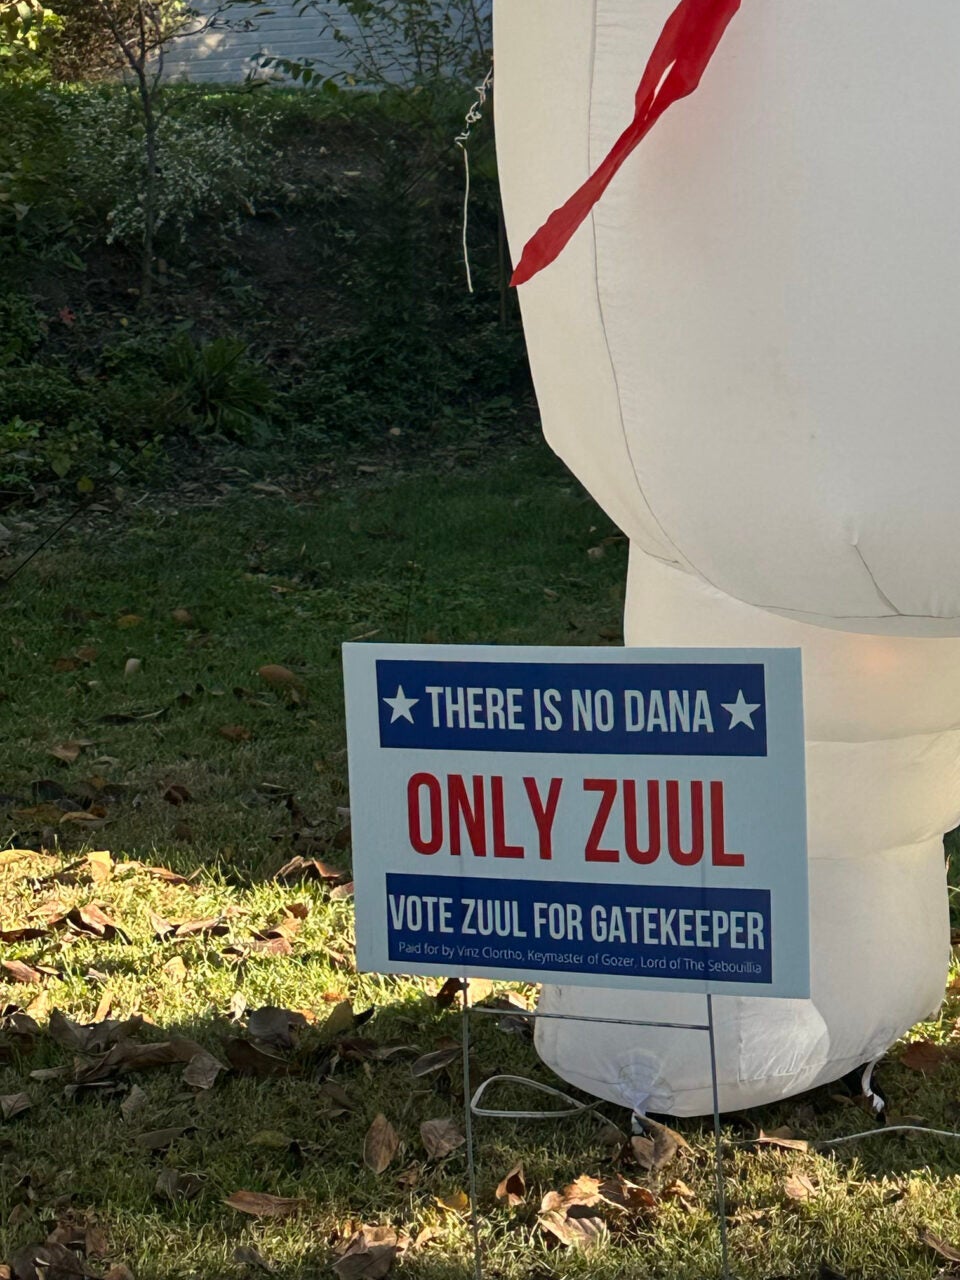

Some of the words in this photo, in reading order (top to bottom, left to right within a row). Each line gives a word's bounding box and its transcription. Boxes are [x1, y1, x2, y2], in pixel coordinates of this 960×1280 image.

[425, 686, 525, 730] THERE
[535, 688, 563, 731] IS
[573, 689, 614, 733] NO
[625, 689, 714, 733] DANA
[407, 772, 563, 861] ONLY
[583, 778, 745, 867] ZUUL
[388, 894, 454, 933] VOTE
[461, 898, 527, 939] ZUUL
[534, 902, 583, 942] FOR
[590, 905, 765, 949] GATEKEEPER
[398, 941, 422, 954] Paid
[424, 942, 439, 954] for
[442, 944, 455, 959] by
[457, 945, 480, 958] Vinz
[482, 946, 525, 961] Clortho,
[527, 950, 583, 965] Keymaster
[587, 952, 600, 965] of
[601, 954, 638, 969] Gozer,
[641, 956, 667, 969] Lord
[669, 957, 682, 970] of
[683, 958, 705, 971] The
